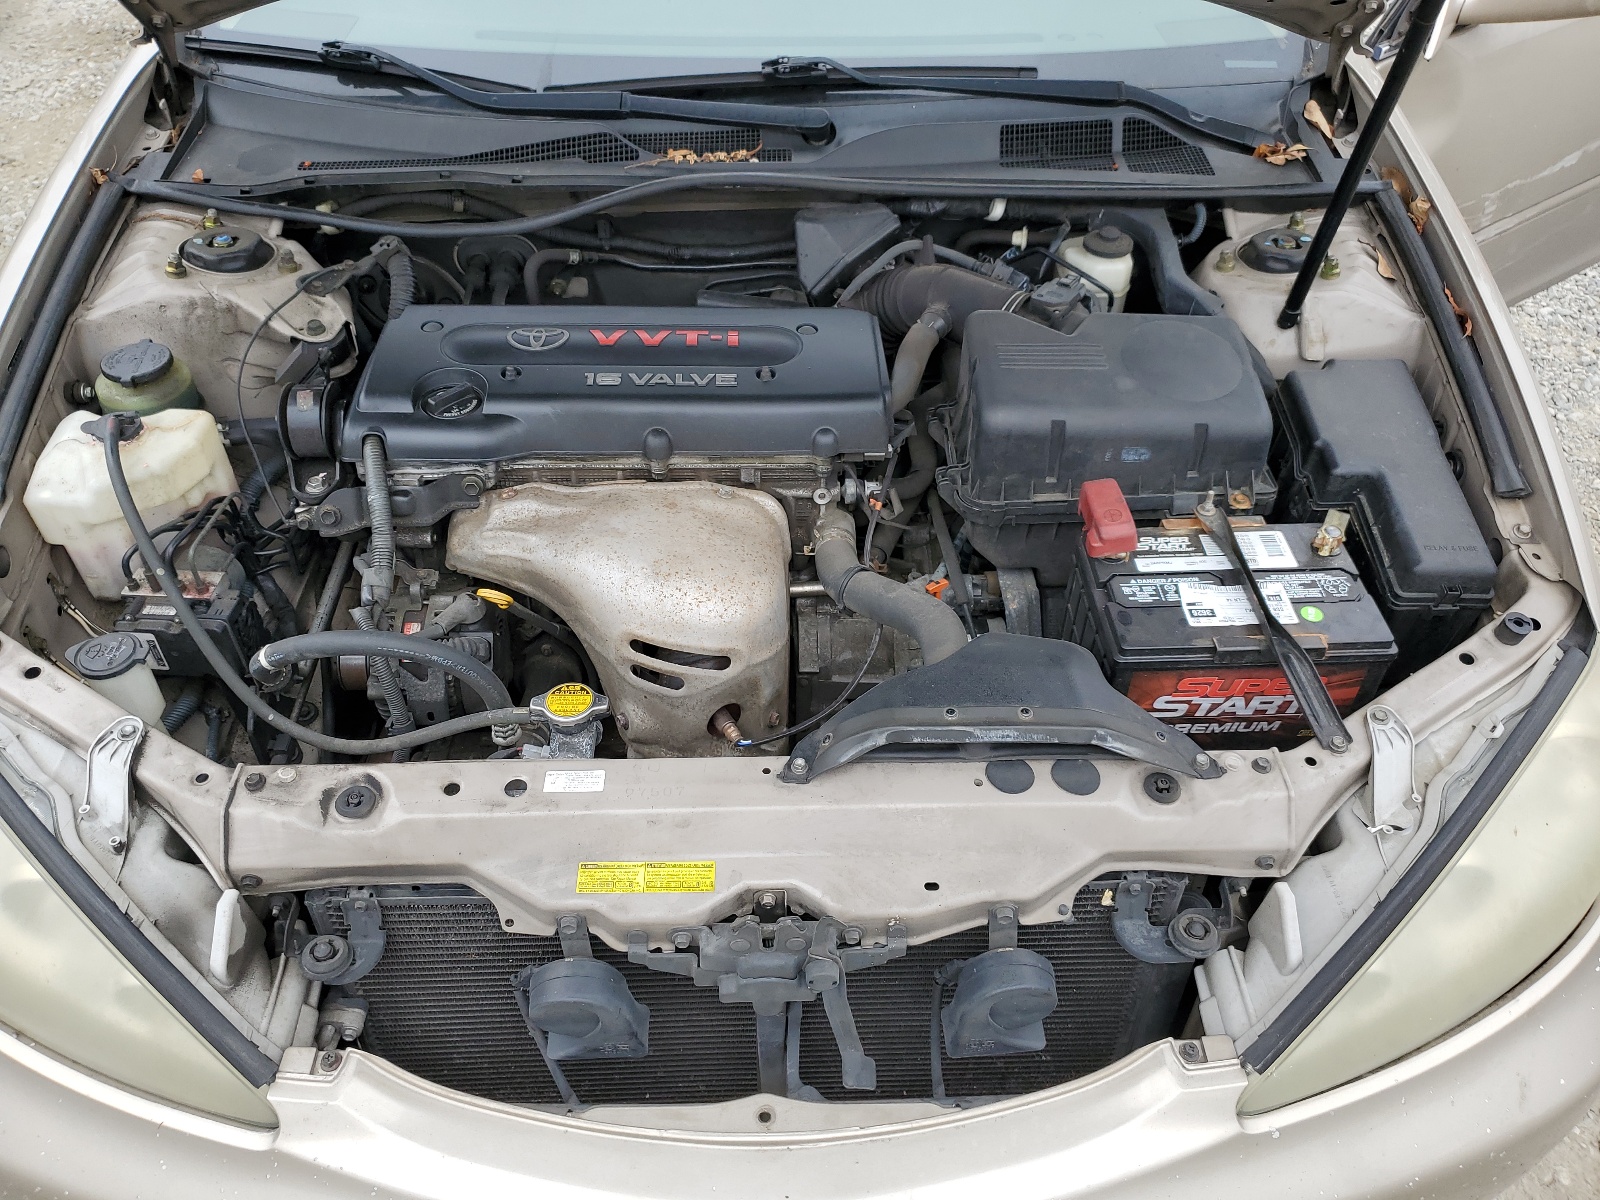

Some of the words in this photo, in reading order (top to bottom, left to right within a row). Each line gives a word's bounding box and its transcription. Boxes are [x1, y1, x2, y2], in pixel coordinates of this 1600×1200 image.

[589, 329, 739, 347] VVT-i
[584, 372, 622, 386] 16
[628, 373, 738, 387] VALVE
[1136, 543, 1191, 551] START
[1172, 677, 1328, 697] SUPE
